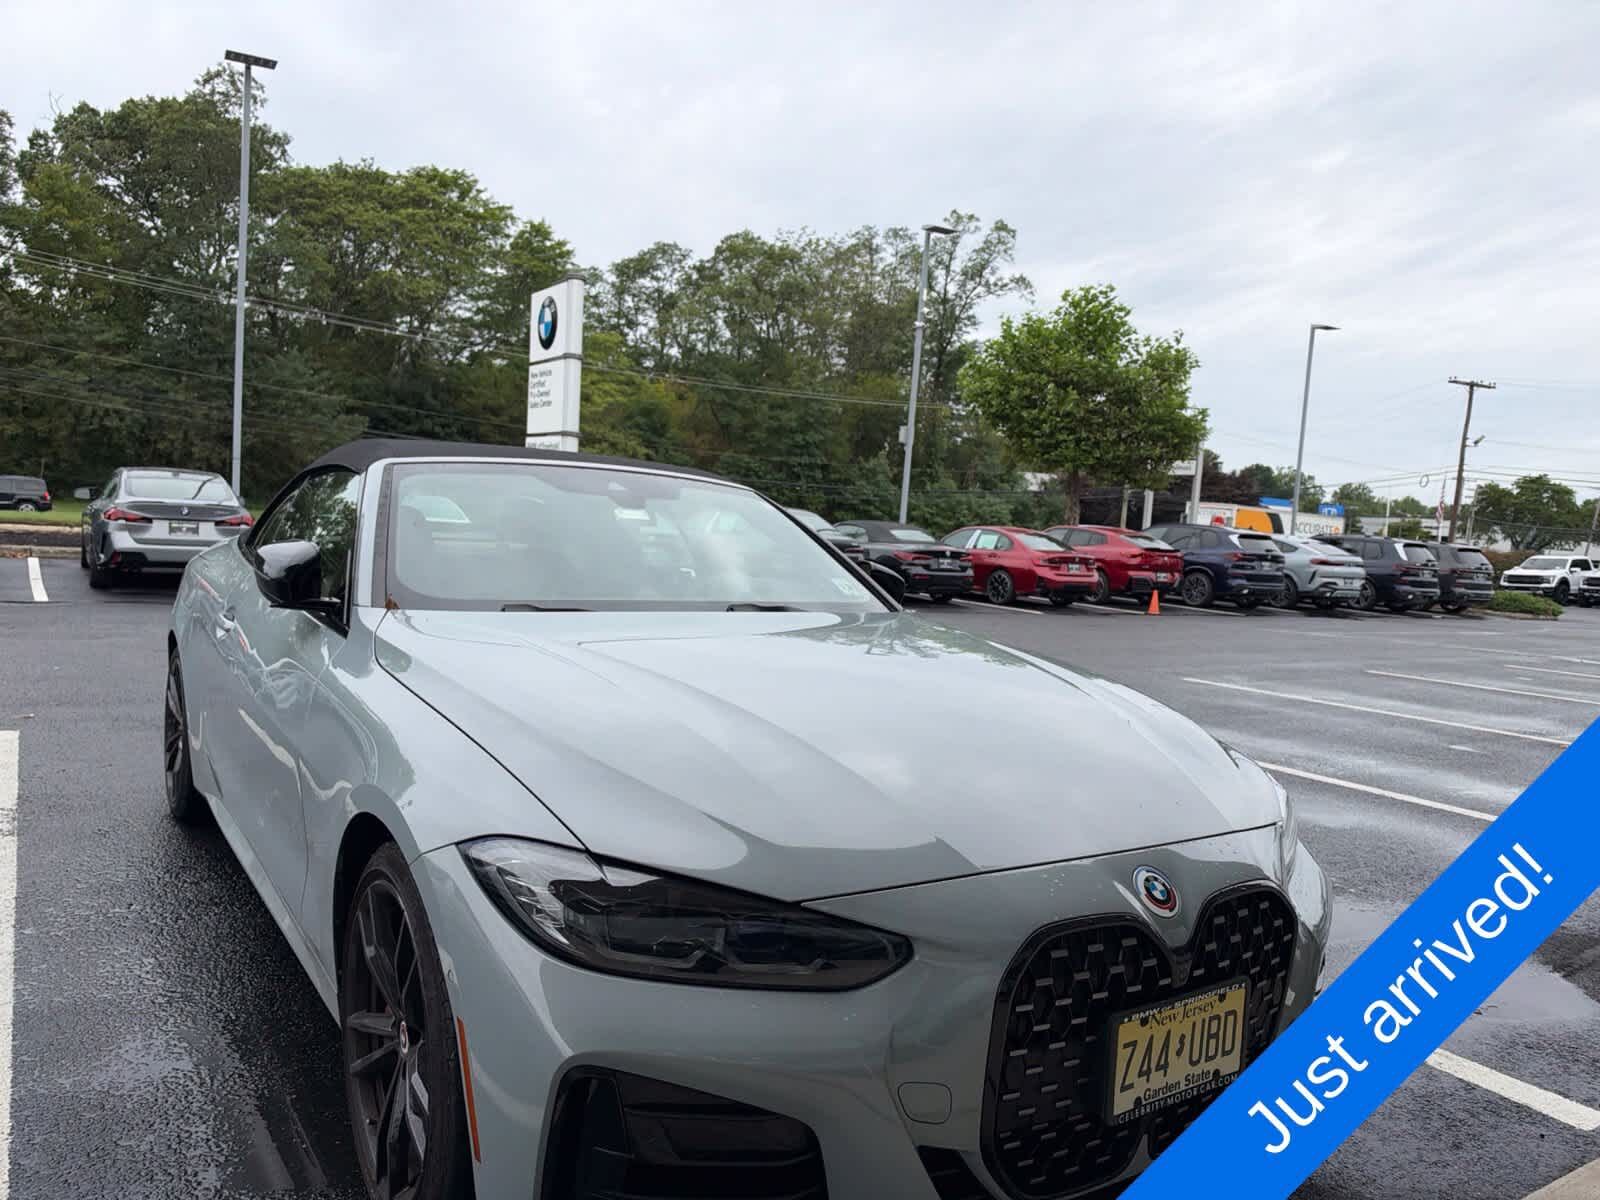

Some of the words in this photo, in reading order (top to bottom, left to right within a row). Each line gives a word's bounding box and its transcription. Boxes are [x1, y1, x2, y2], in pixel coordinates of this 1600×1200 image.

[1150, 1013, 1177, 1029] New
[1179, 1000, 1217, 1024] Jersey
[1143, 1080, 1181, 1102] Garden
[1184, 1068, 1211, 1087] State
